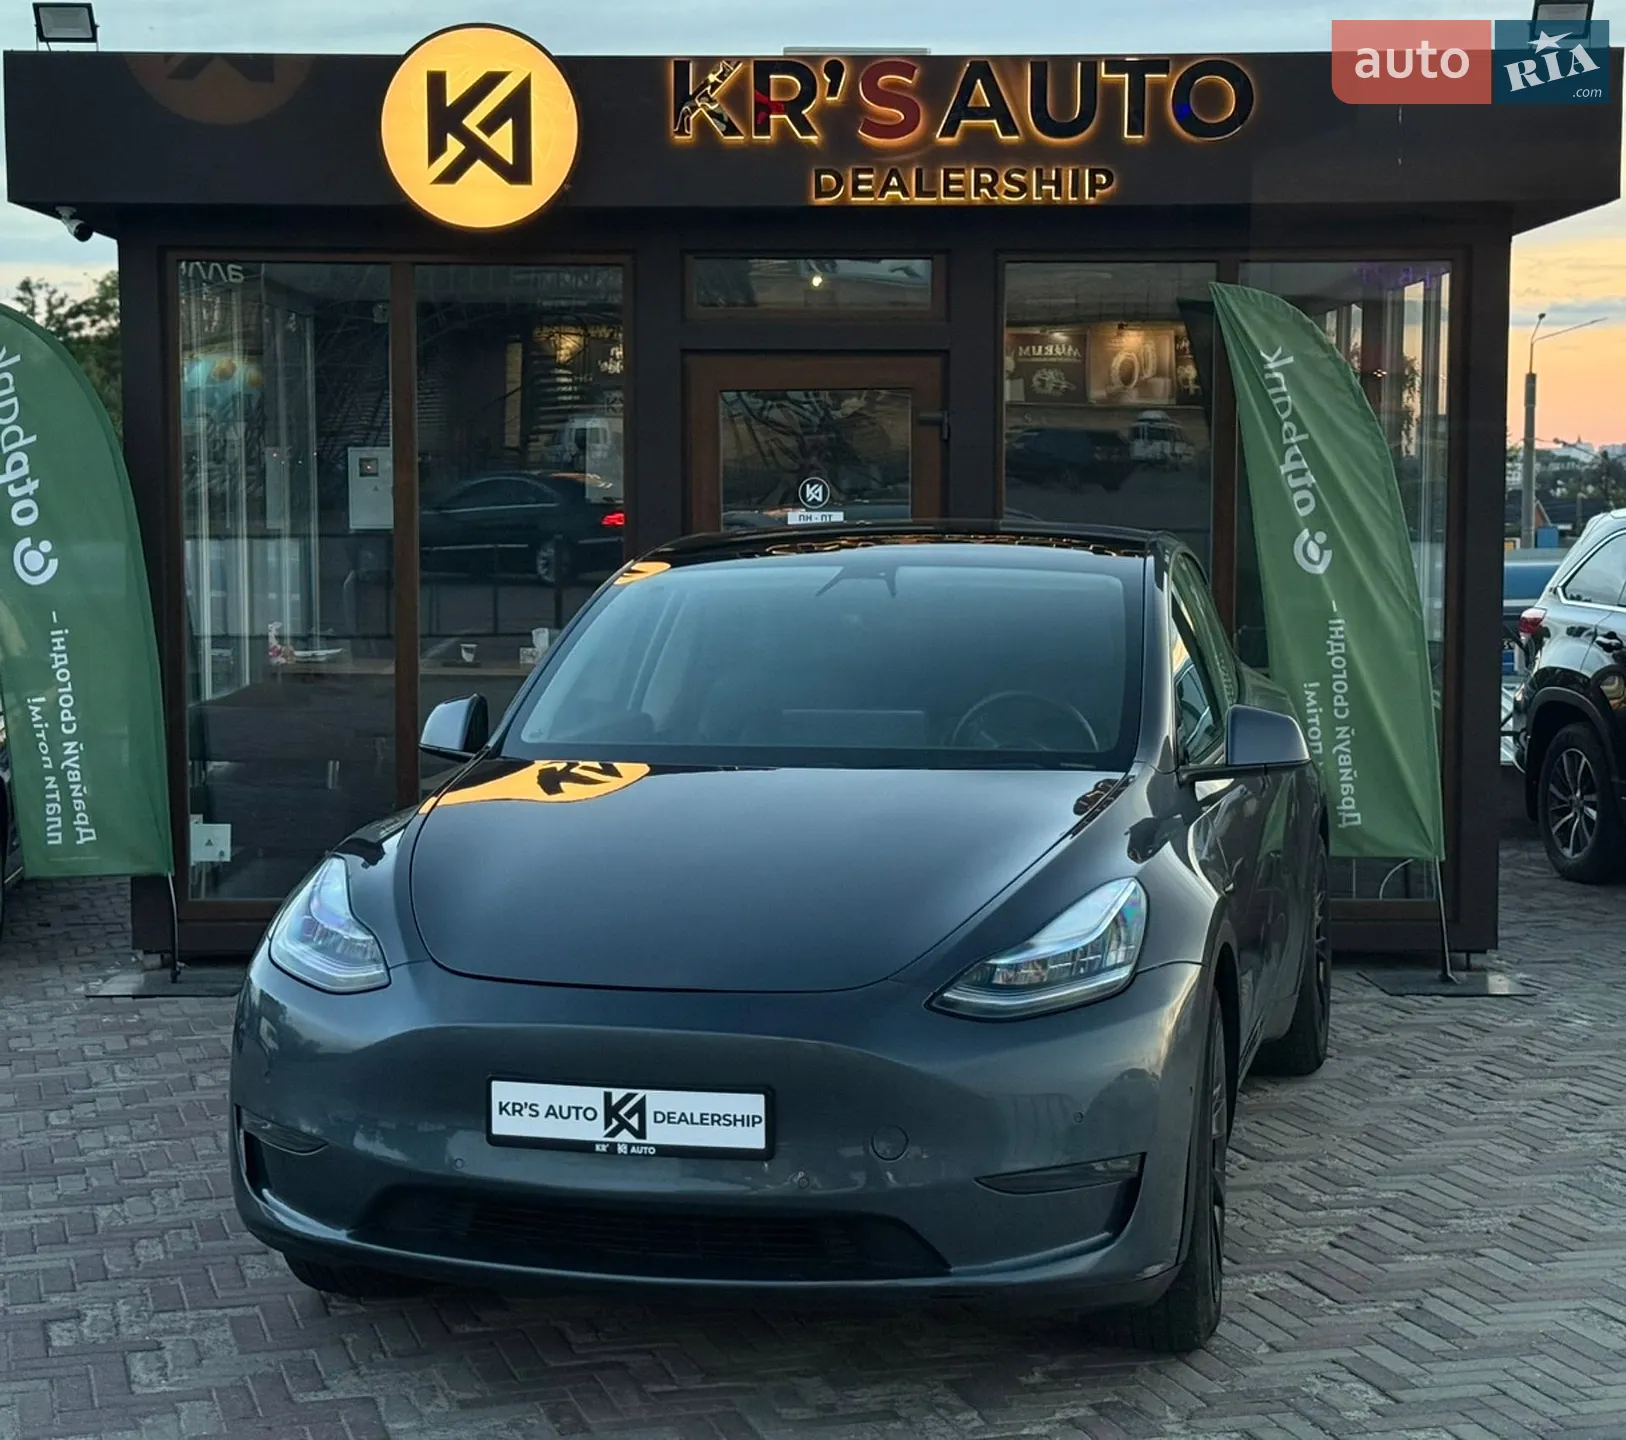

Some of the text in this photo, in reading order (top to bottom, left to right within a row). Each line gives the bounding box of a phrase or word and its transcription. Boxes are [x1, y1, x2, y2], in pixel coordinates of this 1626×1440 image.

[672, 58, 1255, 141] KR'S AUTO
[812, 166, 1115, 202] DEALERSHIP
[498, 1101, 540, 1118] KR'S
[544, 1104, 598, 1121] AUTO
[653, 1111, 763, 1127] DEALERSHIP
[630, 1146, 656, 1155] AUTO
